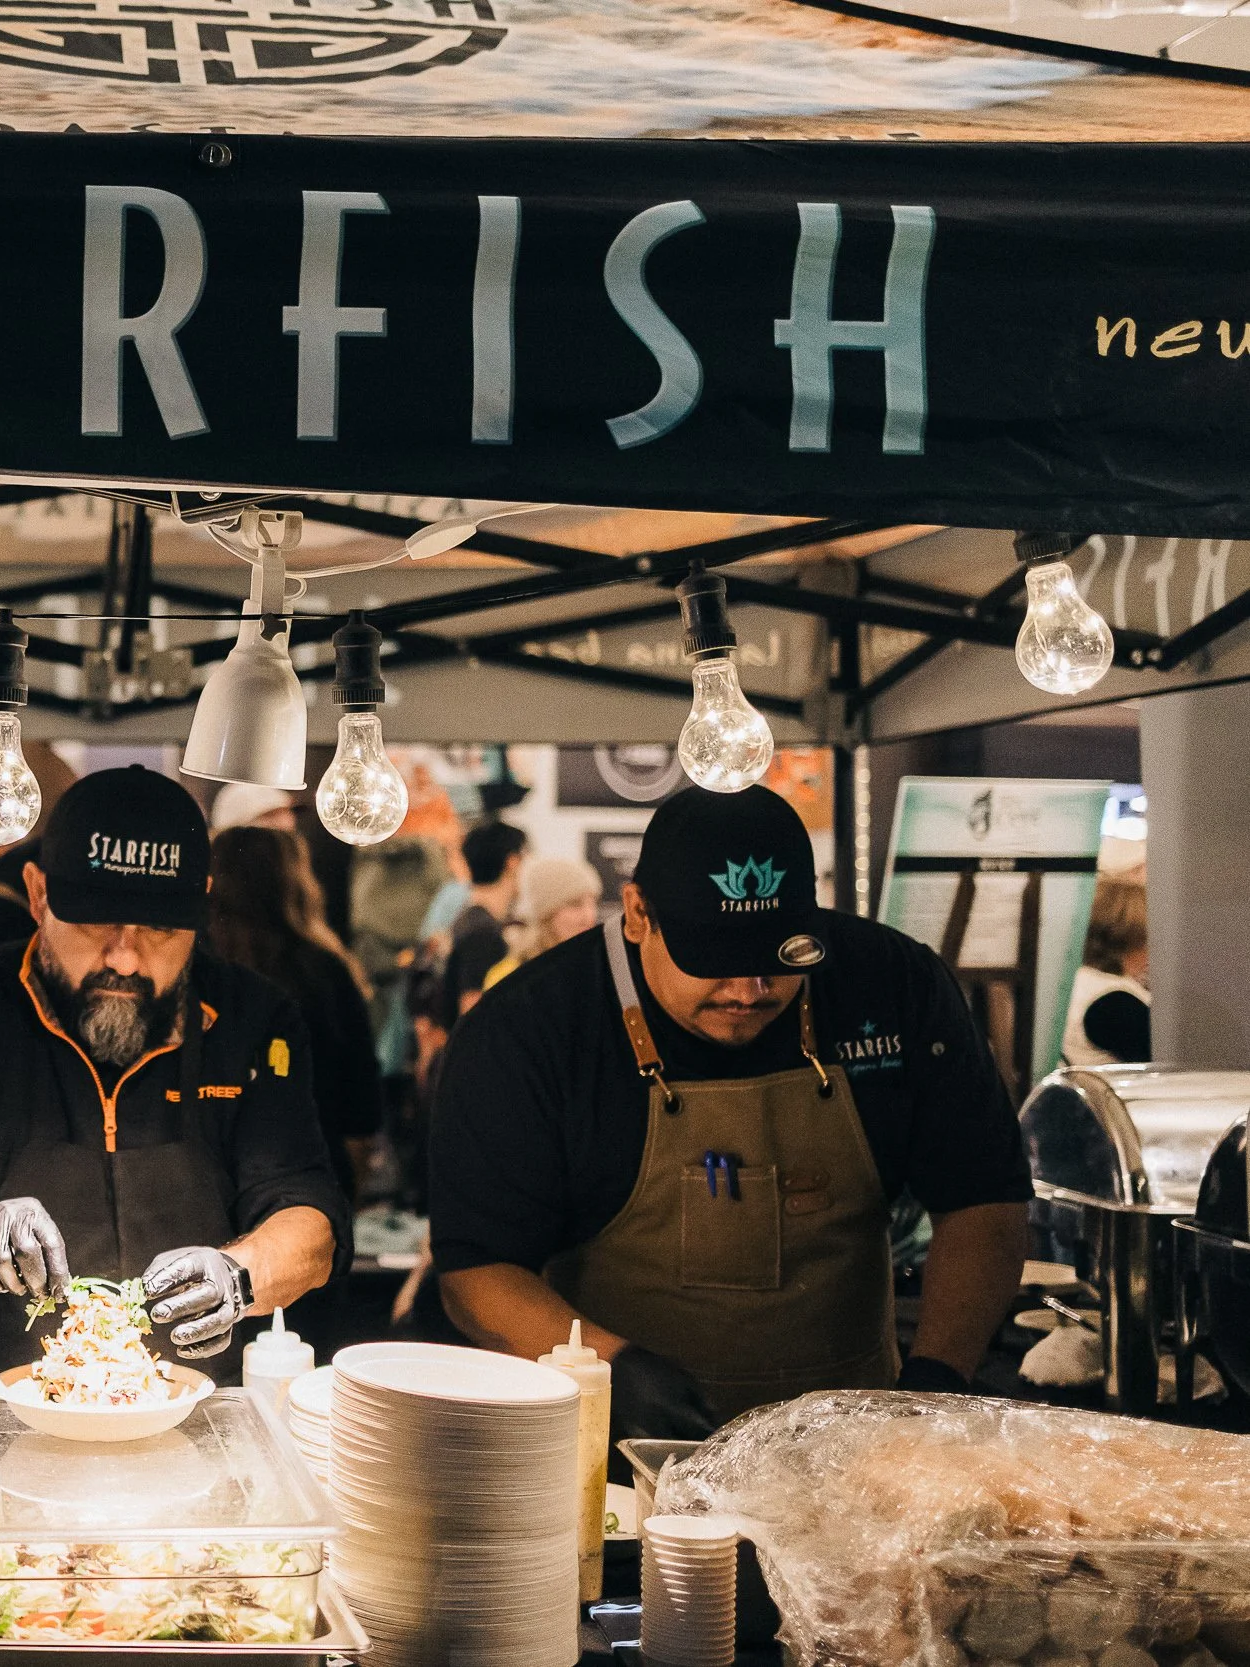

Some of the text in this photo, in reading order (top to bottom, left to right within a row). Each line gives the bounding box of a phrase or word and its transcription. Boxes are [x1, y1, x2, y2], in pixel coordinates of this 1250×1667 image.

[87, 832, 181, 868] STARFISH
[103, 862, 177, 878] newport beach
[720, 897, 780, 913] STARFISH
